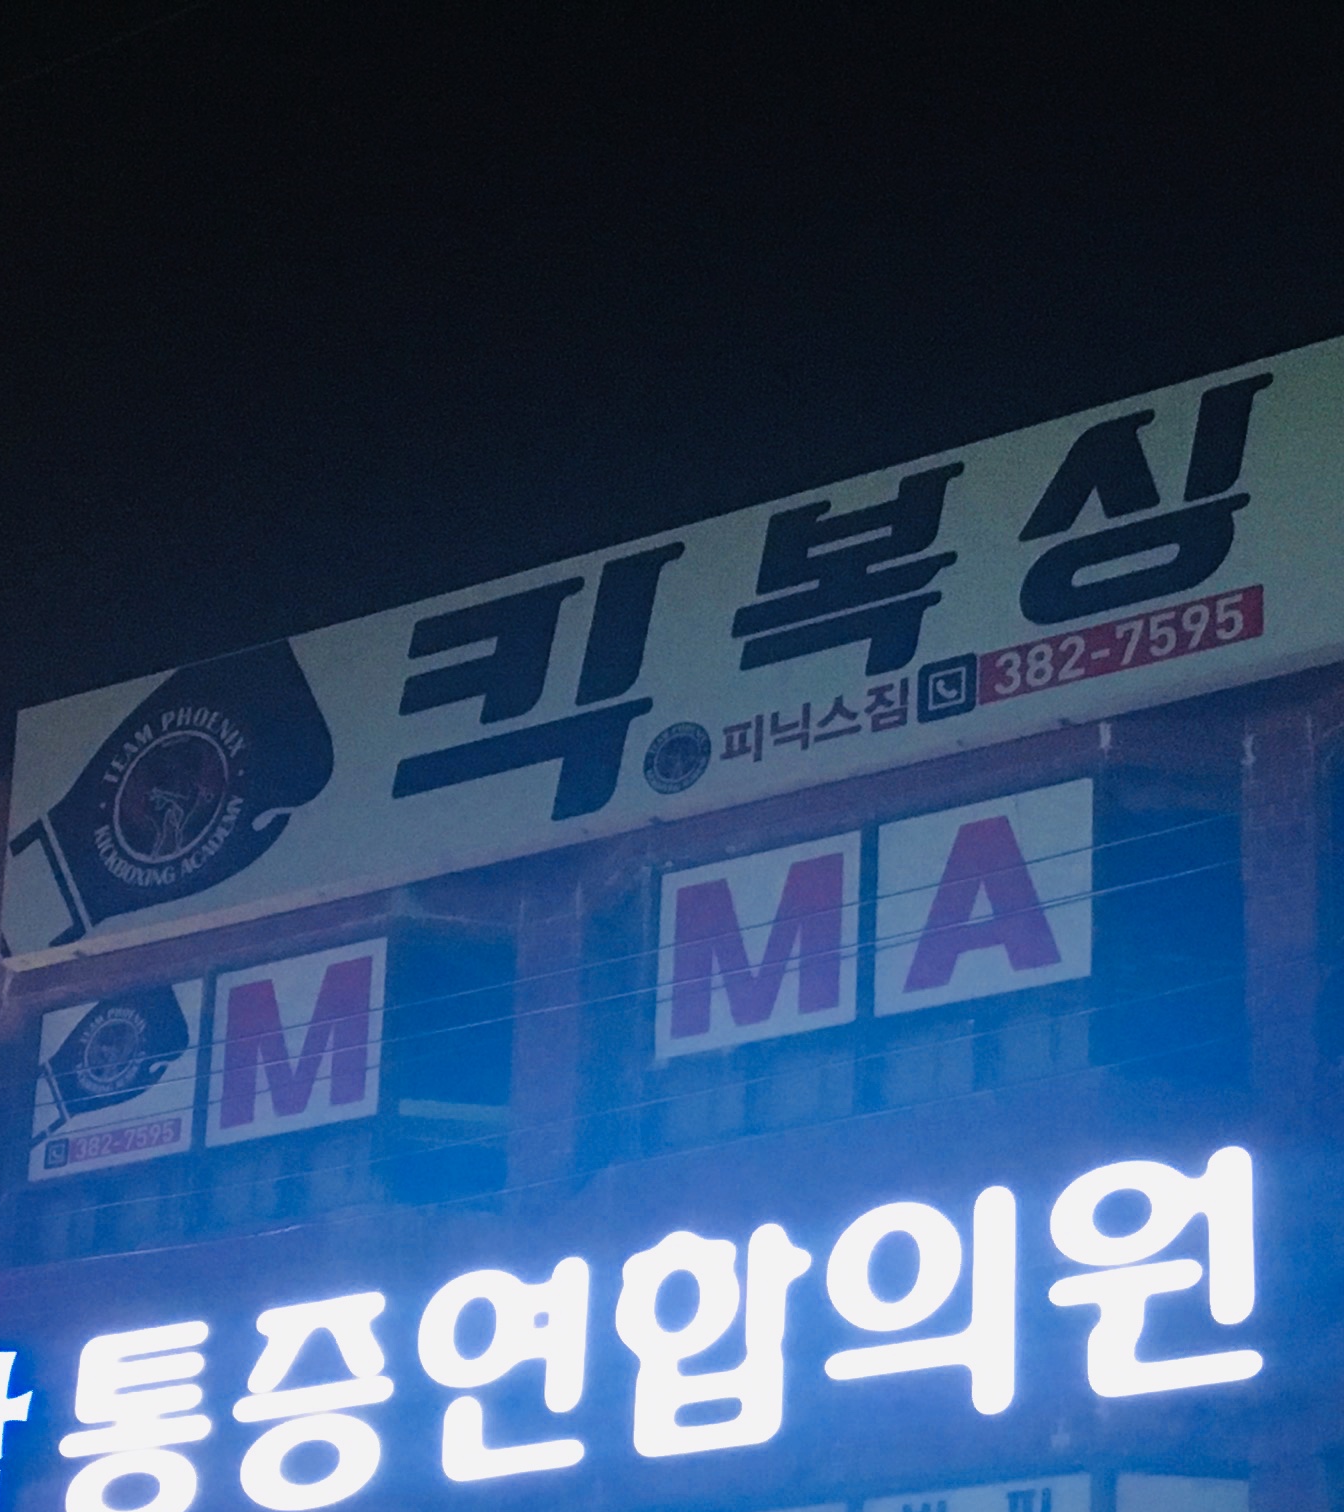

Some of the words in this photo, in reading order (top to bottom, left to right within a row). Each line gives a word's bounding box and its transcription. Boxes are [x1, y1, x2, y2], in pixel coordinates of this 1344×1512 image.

[720, 679, 913, 762] 피닉스짐
[995, 593, 1246, 697] 382-7595
[103, 721, 154, 784] TEAM
[161, 705, 248, 760] PHOENIX
[93, 823, 177, 887] KICKBOXING
[76, 1119, 176, 1159] 382-7595
